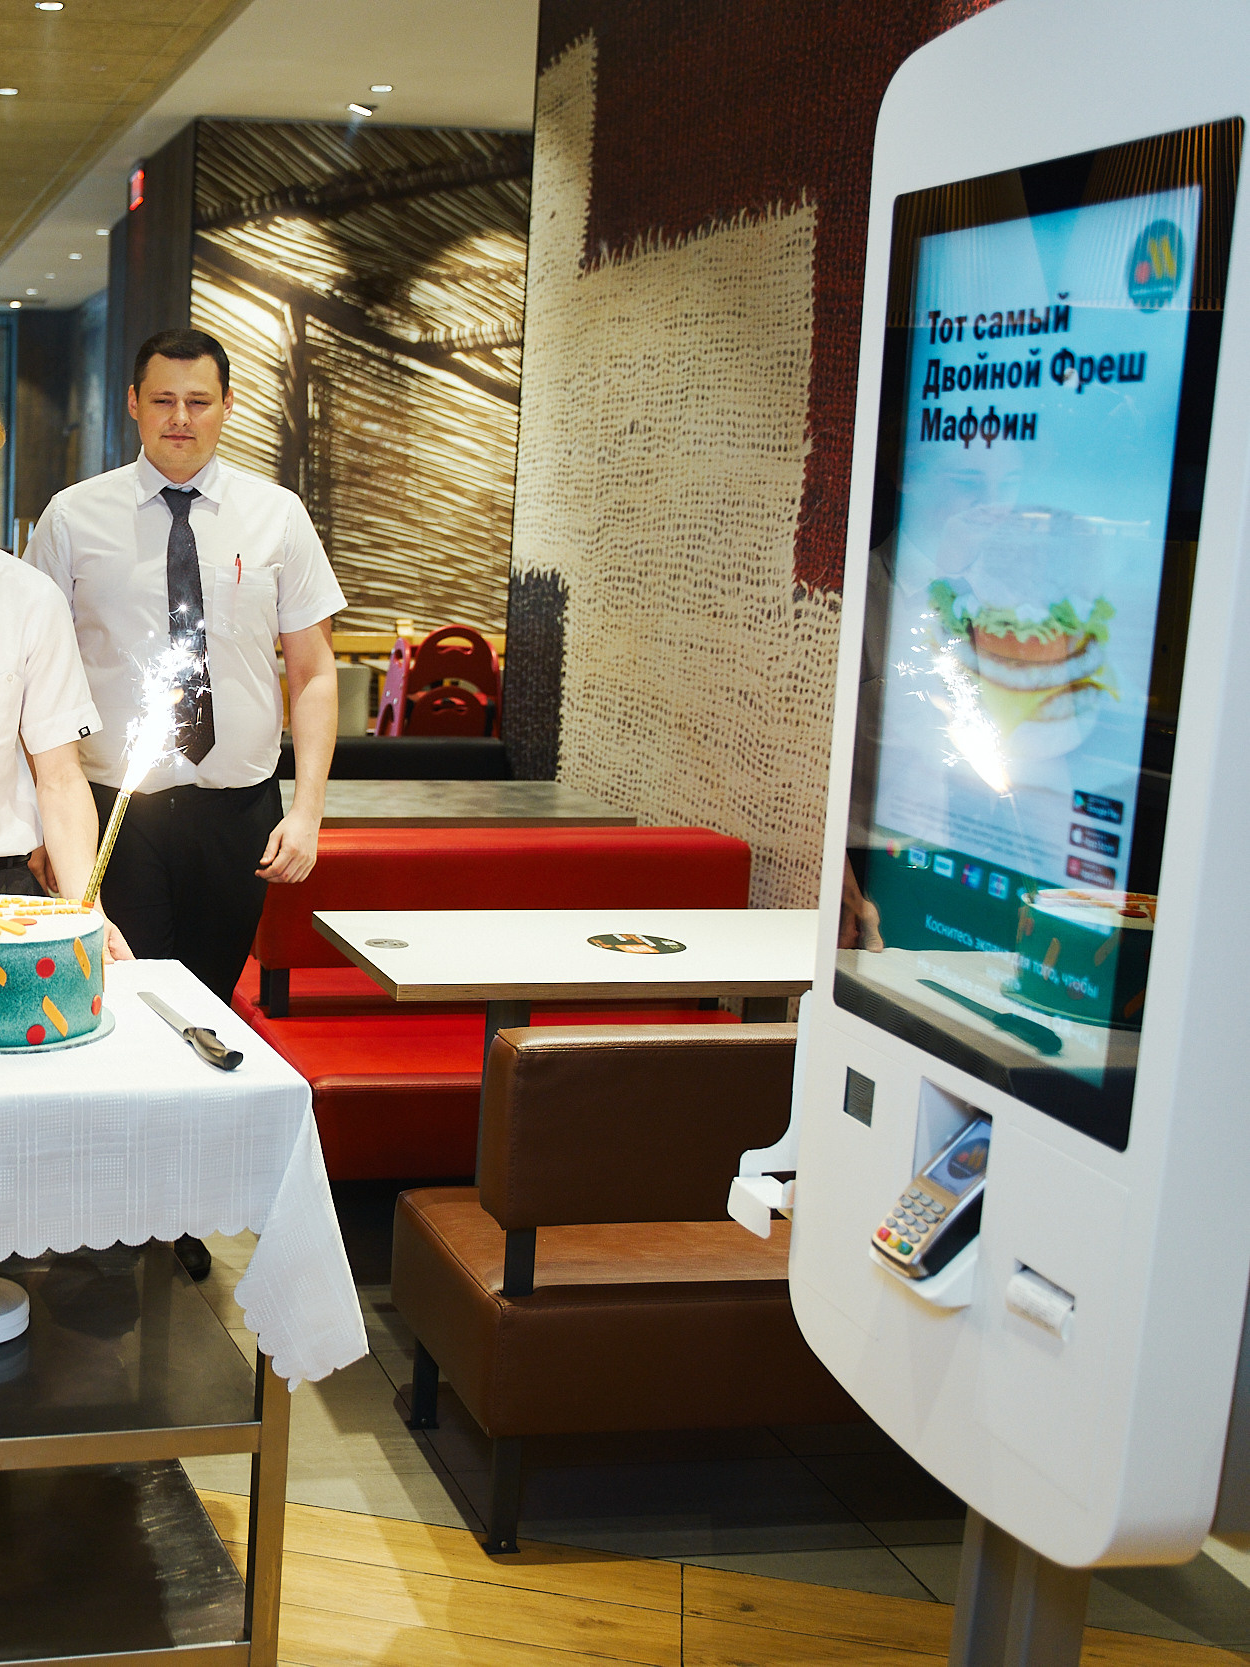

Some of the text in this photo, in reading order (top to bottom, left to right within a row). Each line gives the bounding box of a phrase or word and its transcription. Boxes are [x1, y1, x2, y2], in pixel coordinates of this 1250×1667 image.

[928, 292, 1071, 344] Тот самый
[922, 348, 1146, 399] Двойной Фреш
[920, 405, 1037, 449] Маффин
[924, 914, 974, 948] Коснитесь
